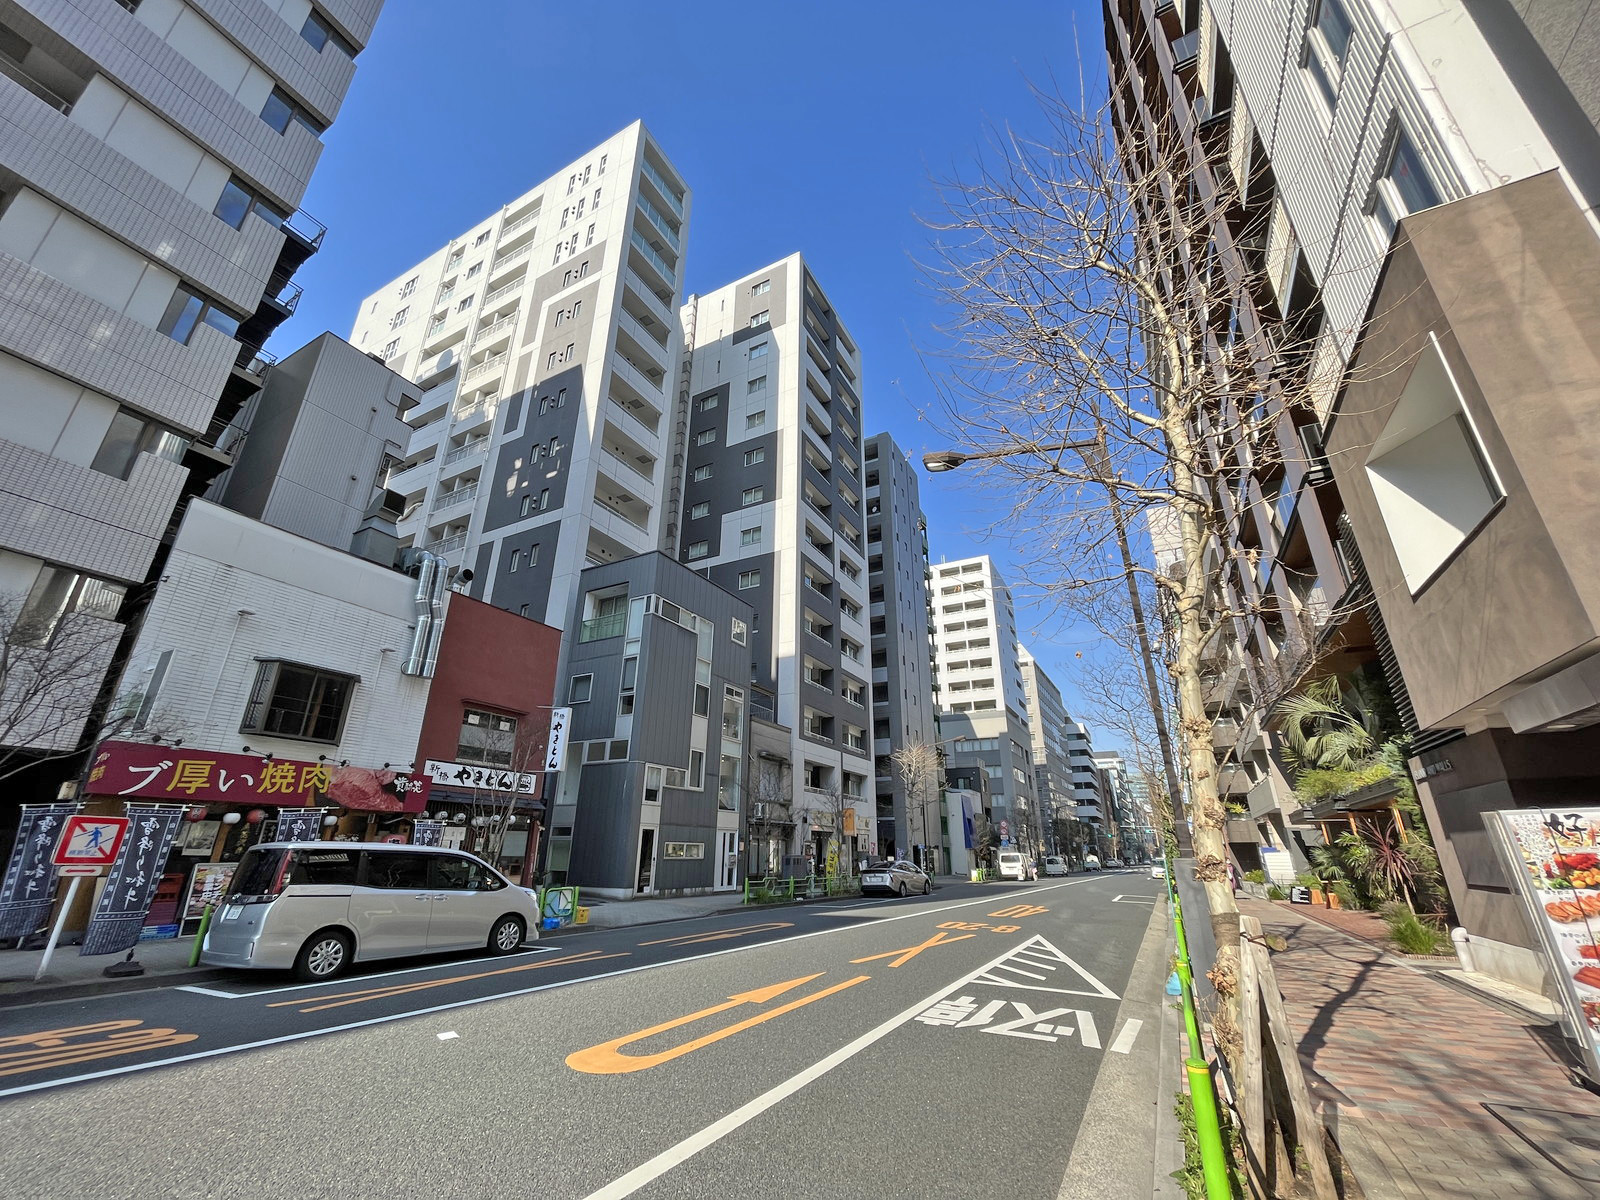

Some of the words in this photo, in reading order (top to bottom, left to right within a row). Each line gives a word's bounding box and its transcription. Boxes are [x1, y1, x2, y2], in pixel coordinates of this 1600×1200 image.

[549, 721, 563, 769] やきとん
[117, 759, 332, 796] ブ厚い焼肉
[453, 766, 513, 790] やきとん
[986, 904, 1050, 918] 40
[935, 921, 1022, 933] 8-20
